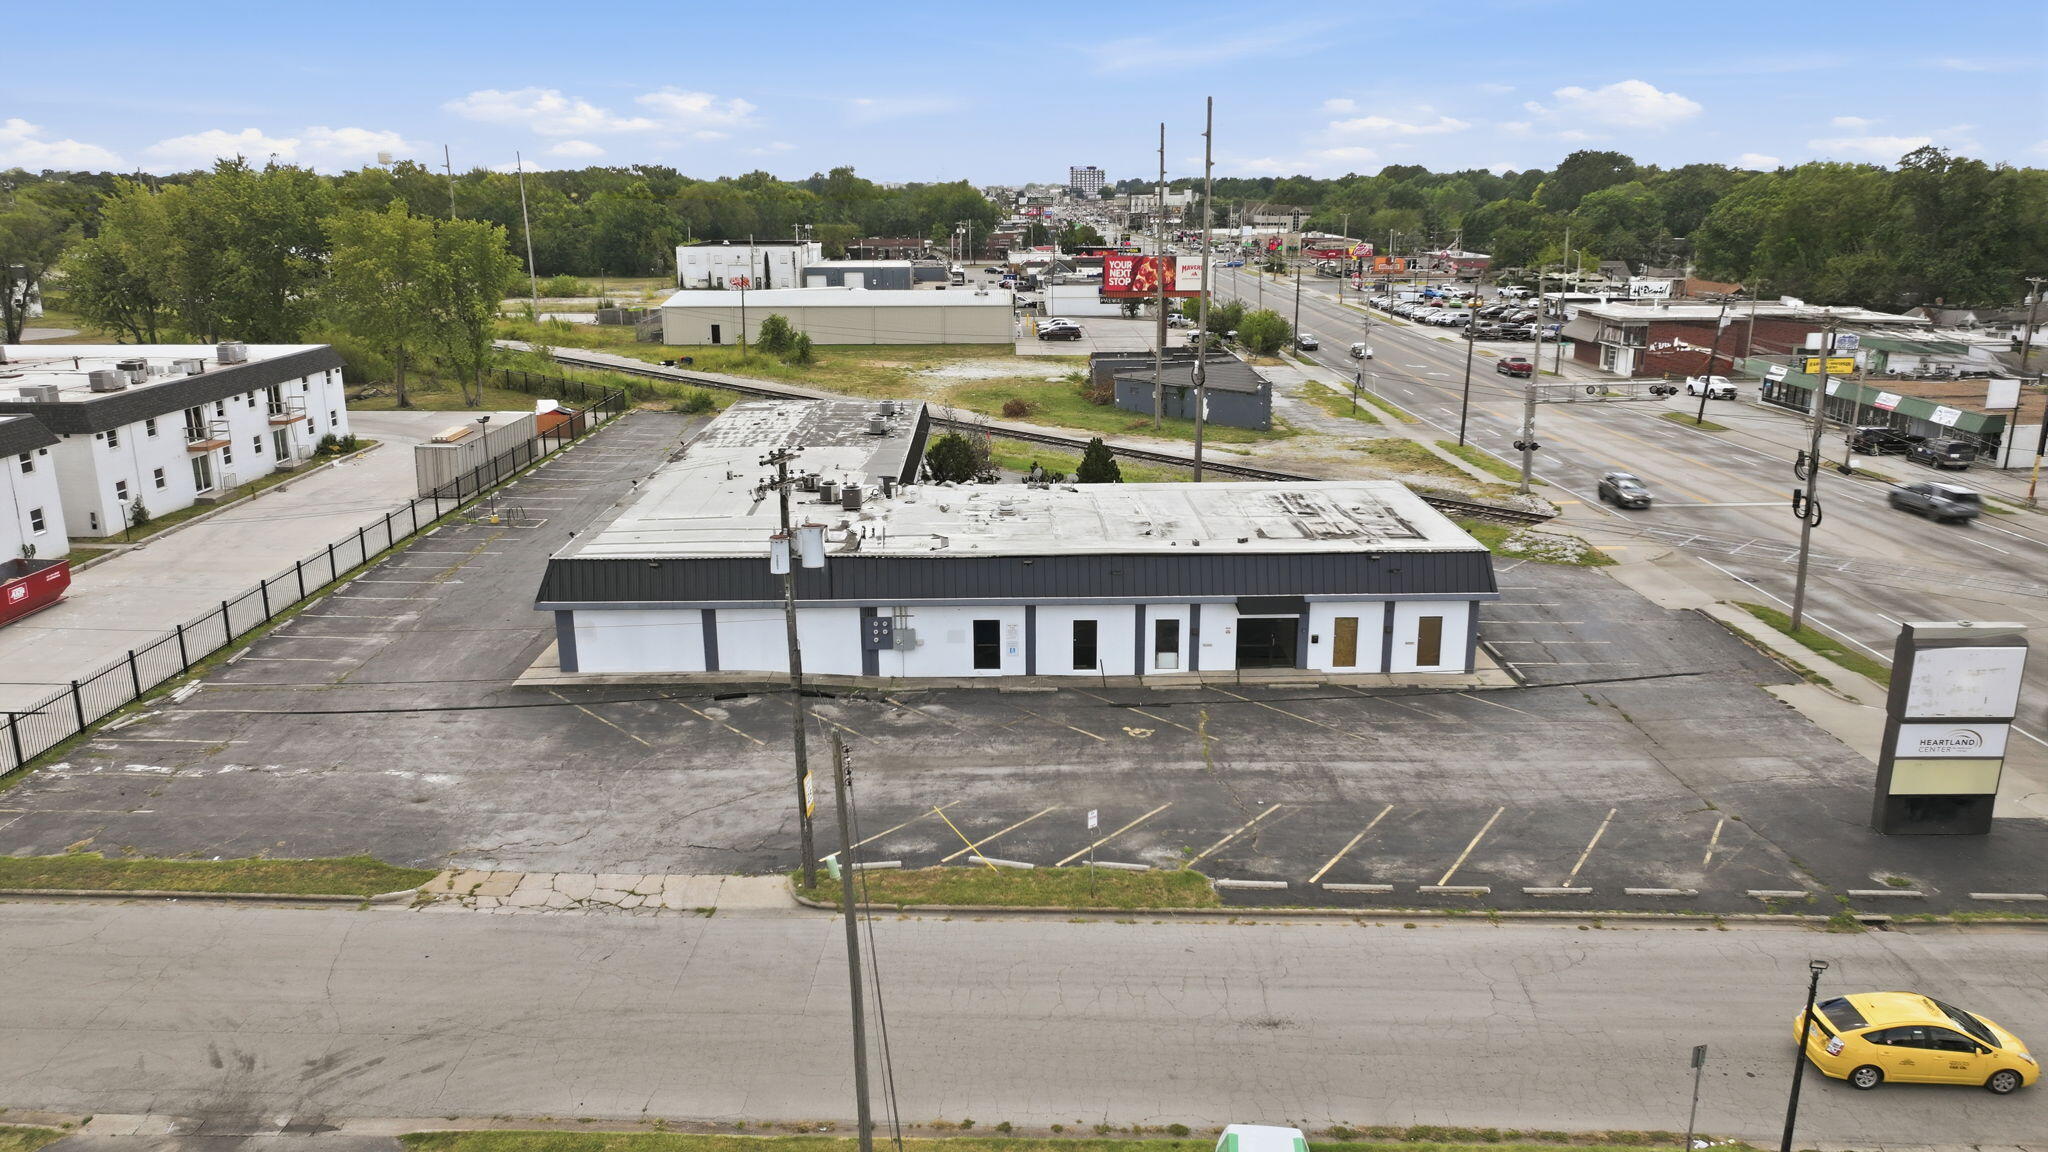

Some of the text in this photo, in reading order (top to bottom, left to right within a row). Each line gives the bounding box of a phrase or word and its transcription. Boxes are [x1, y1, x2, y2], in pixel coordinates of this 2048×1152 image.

[1109, 260, 1132, 269] YOUR
[1109, 269, 1132, 277] NEXT
[1182, 265, 1203, 273] MAVERI
[1108, 277, 1131, 286] STOP
